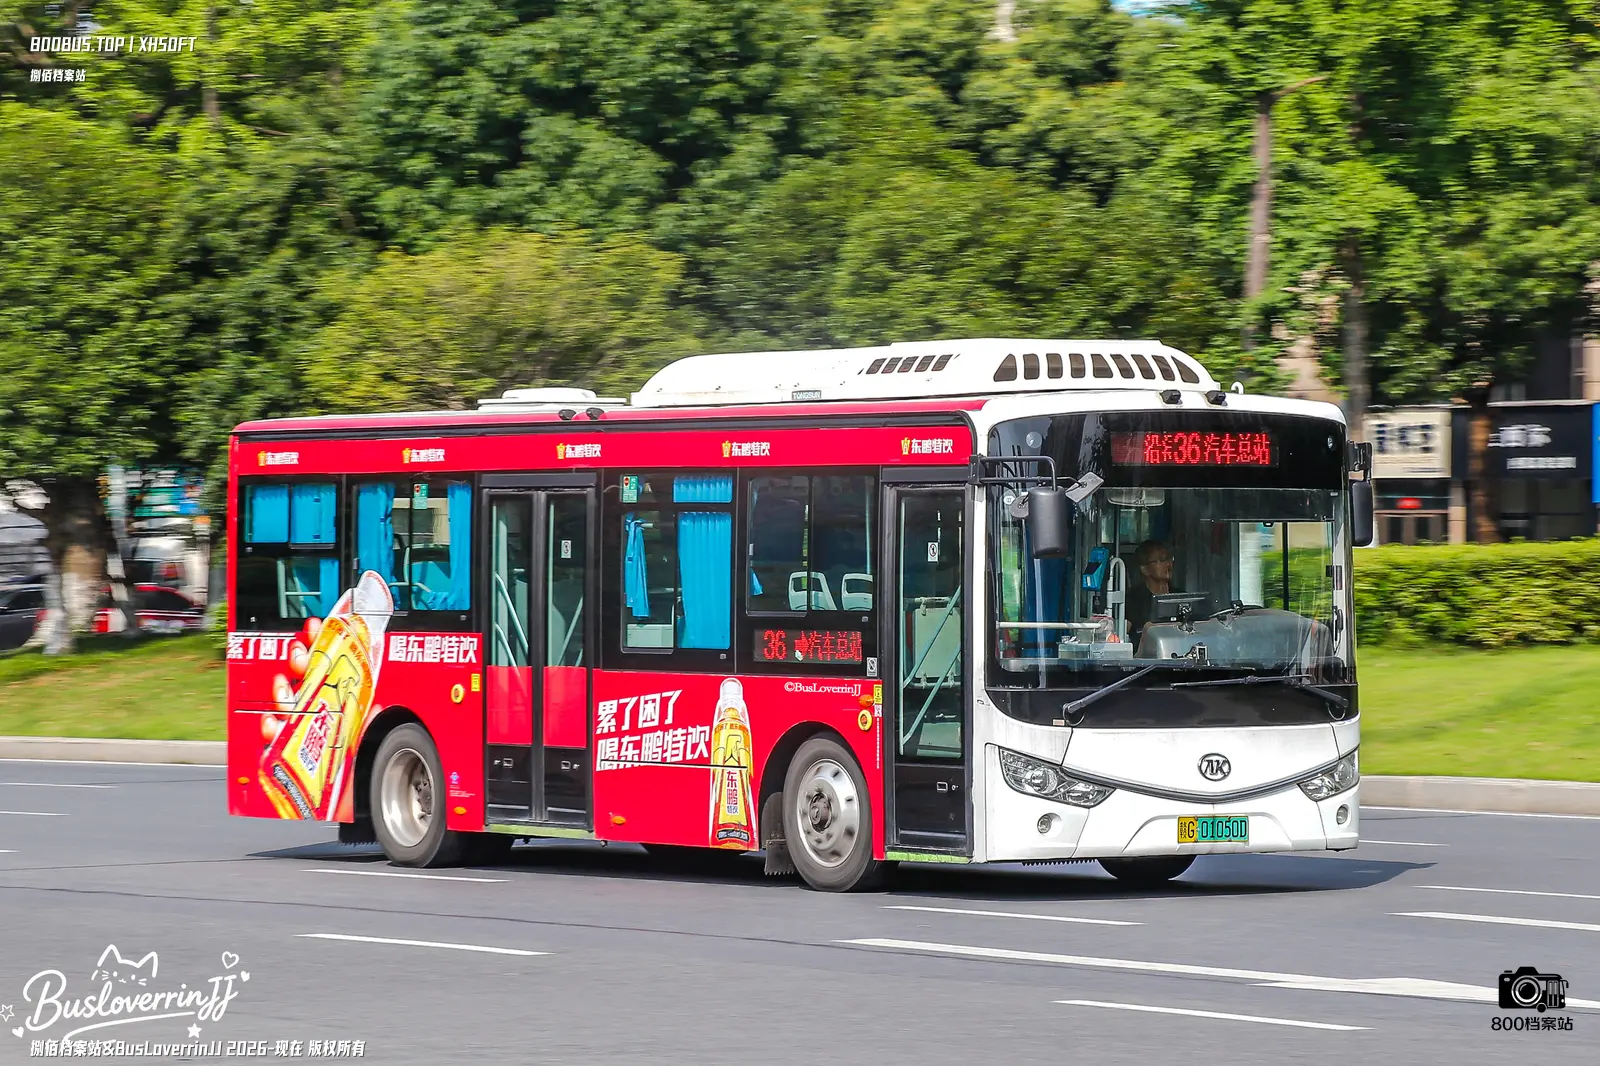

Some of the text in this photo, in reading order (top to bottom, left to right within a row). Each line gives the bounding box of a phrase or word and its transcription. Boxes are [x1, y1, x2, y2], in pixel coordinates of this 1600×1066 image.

[389, 635, 478, 663] 喝东鹏特饮
[763, 629, 787, 660] 36
[596, 689, 683, 735] 累了困了
[596, 724, 711, 772] 喝东鹏特饮
